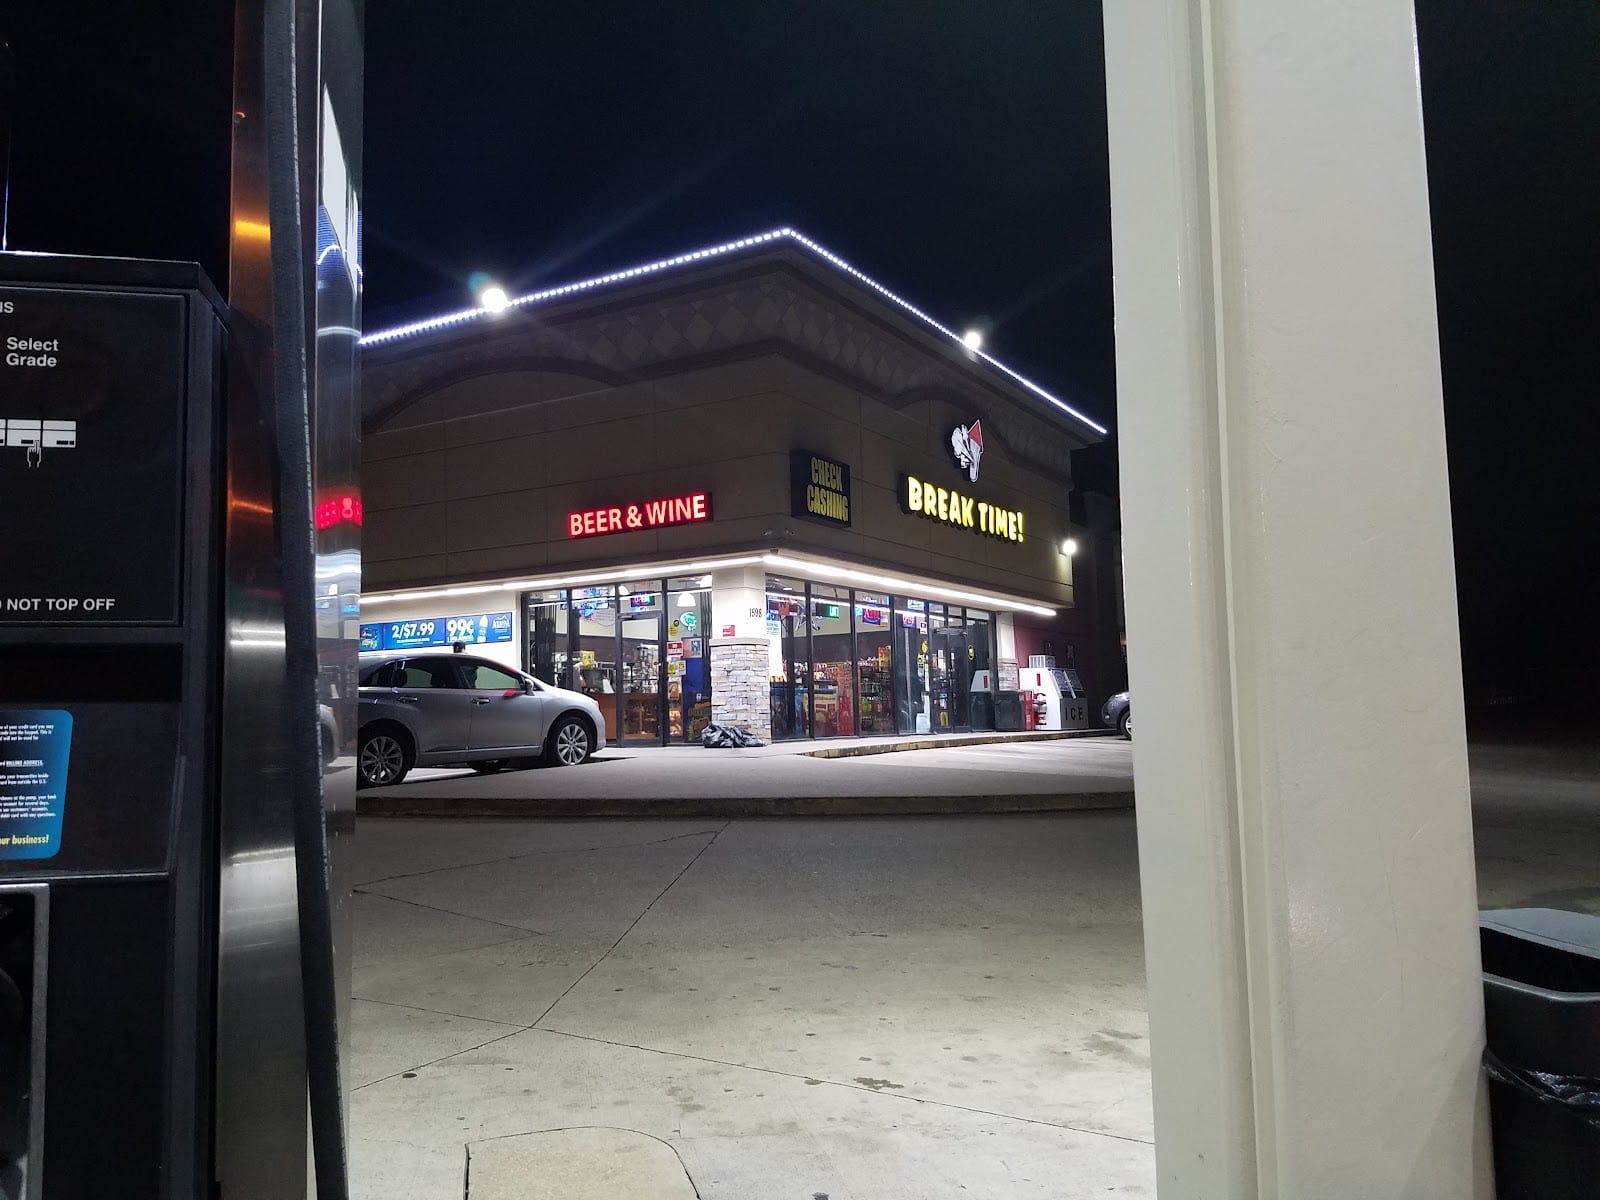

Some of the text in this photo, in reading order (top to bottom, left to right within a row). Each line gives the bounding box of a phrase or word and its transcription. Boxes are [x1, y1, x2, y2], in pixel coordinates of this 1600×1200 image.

[6, 336, 59, 351] Select
[5, 352, 58, 367] Grade
[811, 456, 844, 492] CHECK
[806, 484, 849, 523] CASHING
[908, 476, 1024, 543] BREAK TIME!
[569, 494, 706, 536] BEER & WINE
[7, 598, 41, 611] NOT
[45, 598, 79, 611] TOP
[83, 598, 116, 611] OFF
[392, 622, 435, 639] 2/$7.99
[447, 618, 475, 637] 99¢
[1065, 707, 1085, 721] ICE
[12, 834, 50, 845] business!
